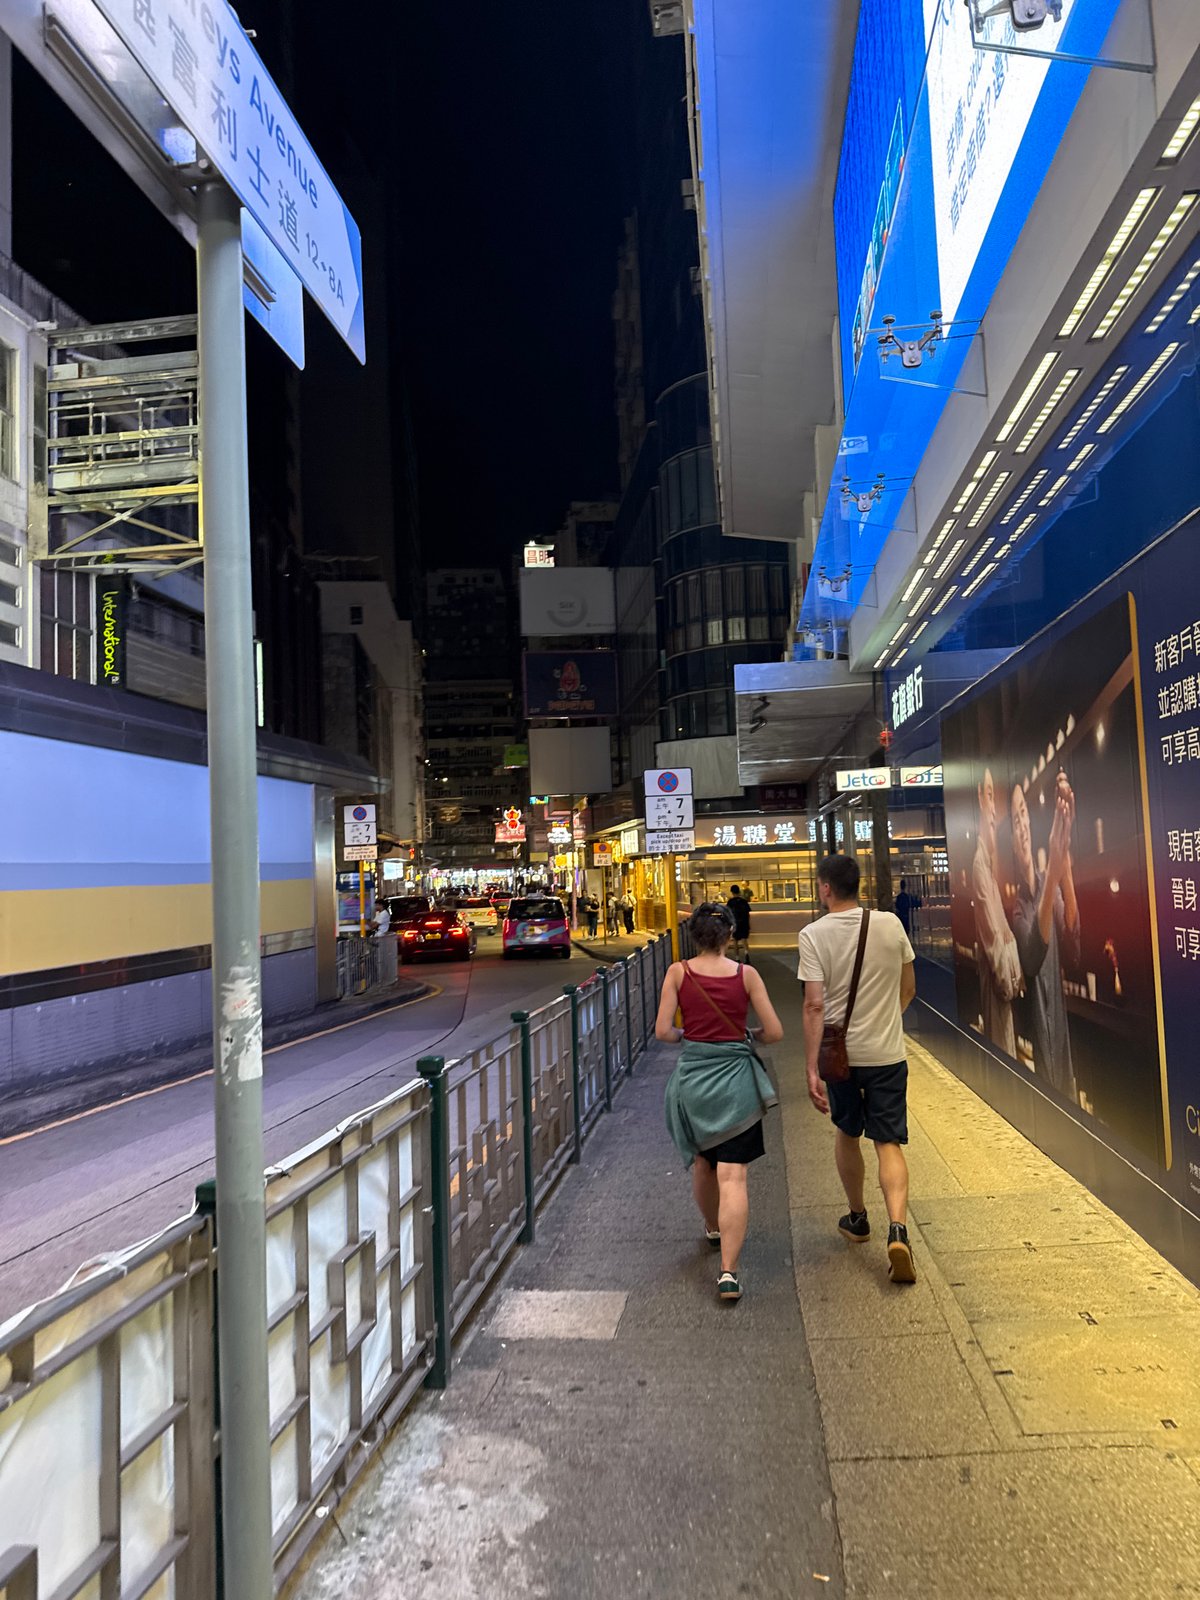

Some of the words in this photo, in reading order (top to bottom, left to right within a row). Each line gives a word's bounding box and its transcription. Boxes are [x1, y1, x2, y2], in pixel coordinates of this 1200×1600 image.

[250, 75, 318, 209] Avenue
[103, 591, 119, 677] International
[892, 664, 923, 730] 花旗銀行
[1157, 672, 1200, 720] 並認購
[676, 798, 684, 809] 7
[677, 815, 684, 826] 7
[365, 835, 371, 843] 7
[713, 821, 796, 846] 湯糖堂
[1171, 877, 1198, 912] 晉身
[1174, 926, 1200, 961] 可享
